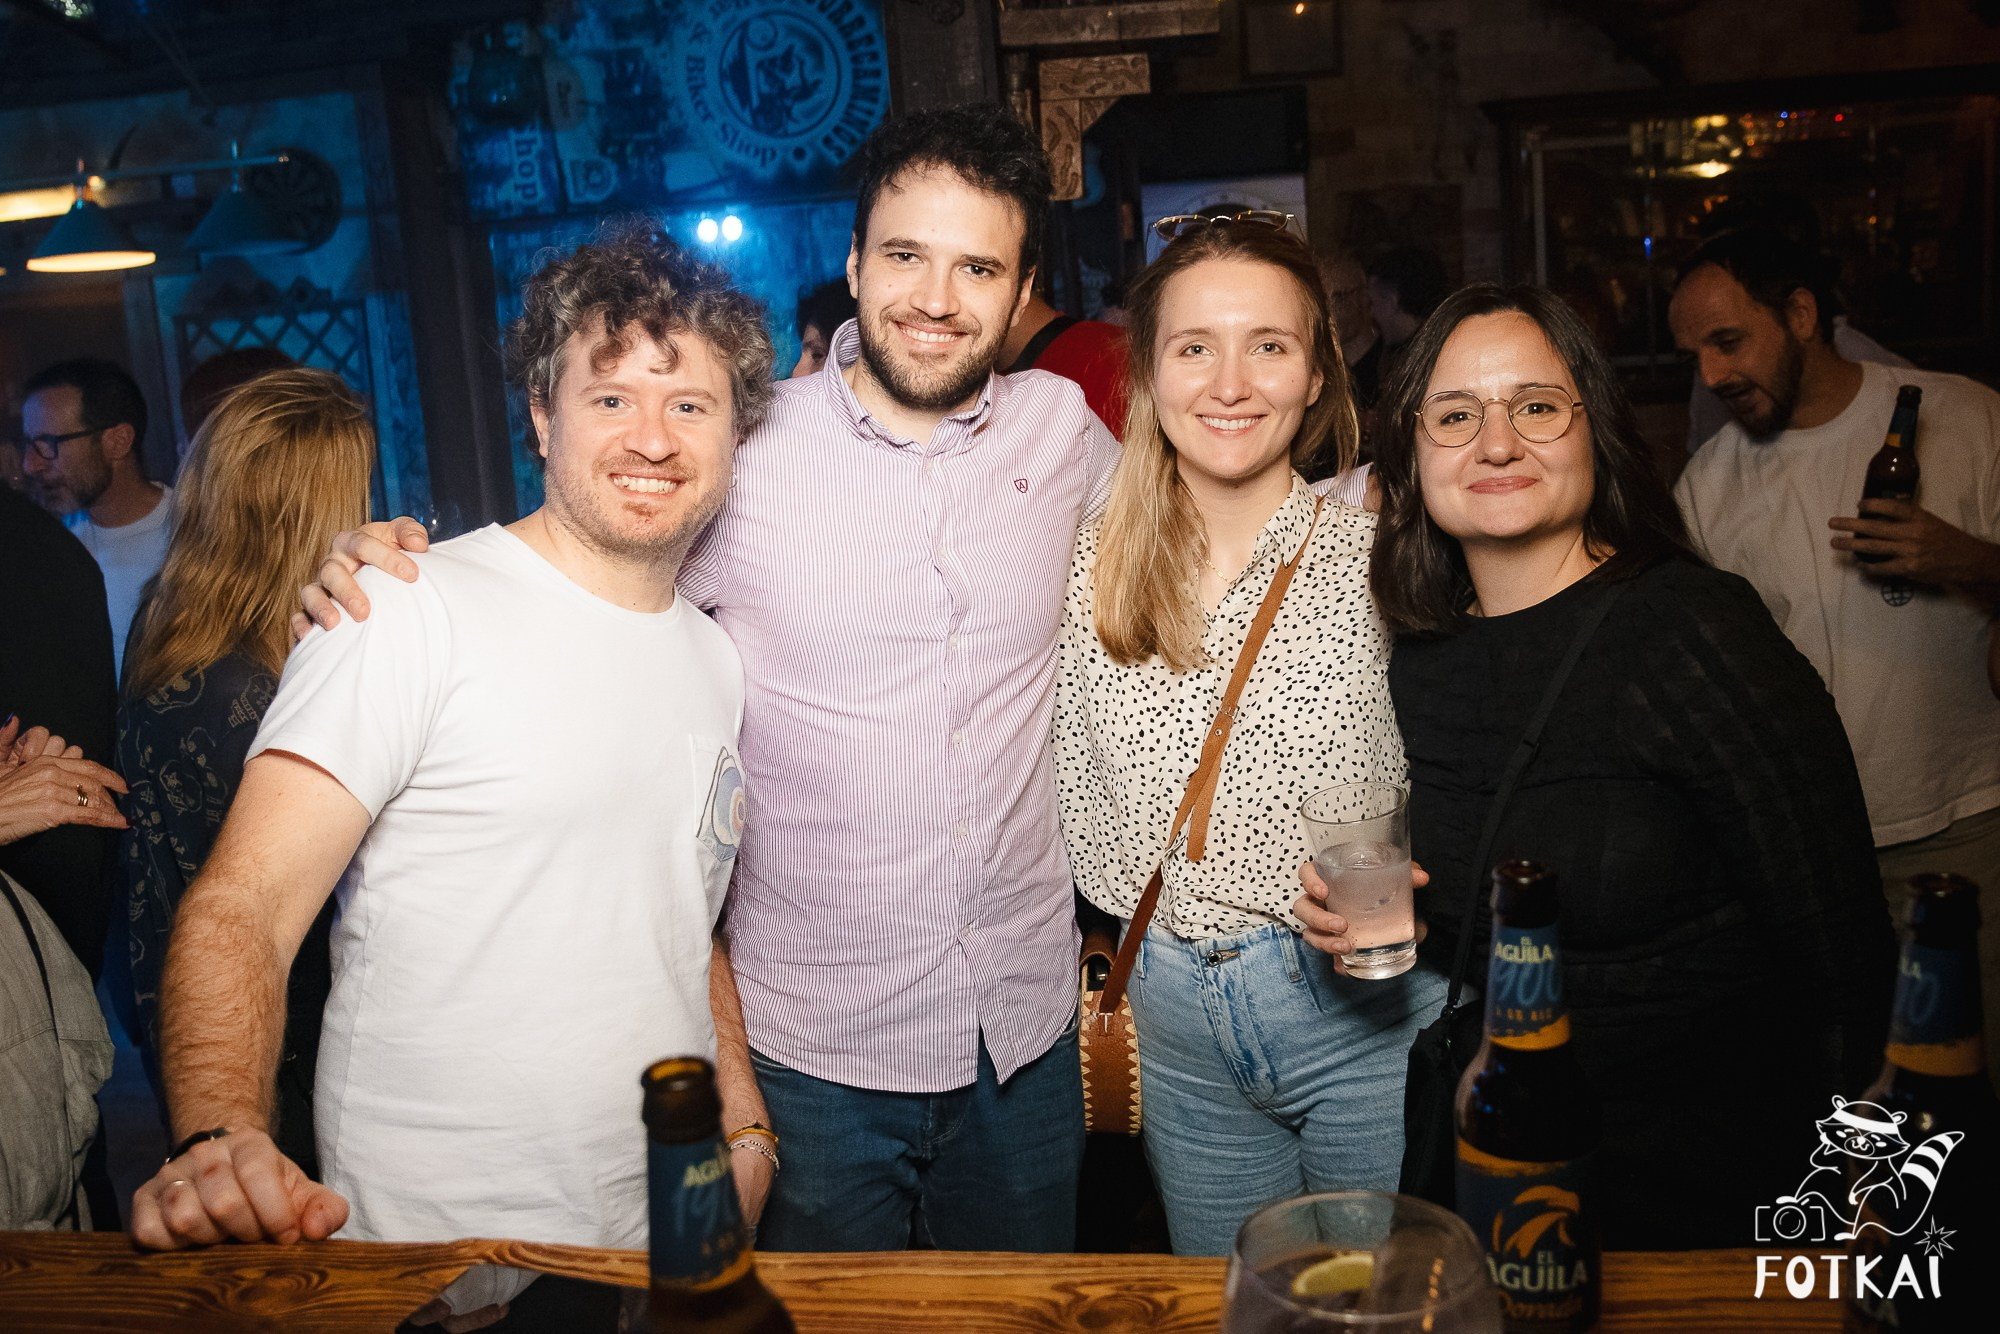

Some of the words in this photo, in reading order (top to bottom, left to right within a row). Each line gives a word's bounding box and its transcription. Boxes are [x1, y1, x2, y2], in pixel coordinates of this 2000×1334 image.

[686, 55, 715, 122] Biker
[720, 123, 777, 169] Shop
[514, 128, 538, 199] hop
[1495, 940, 1554, 964] AGUILA
[1536, 1249, 1555, 1264] EL
